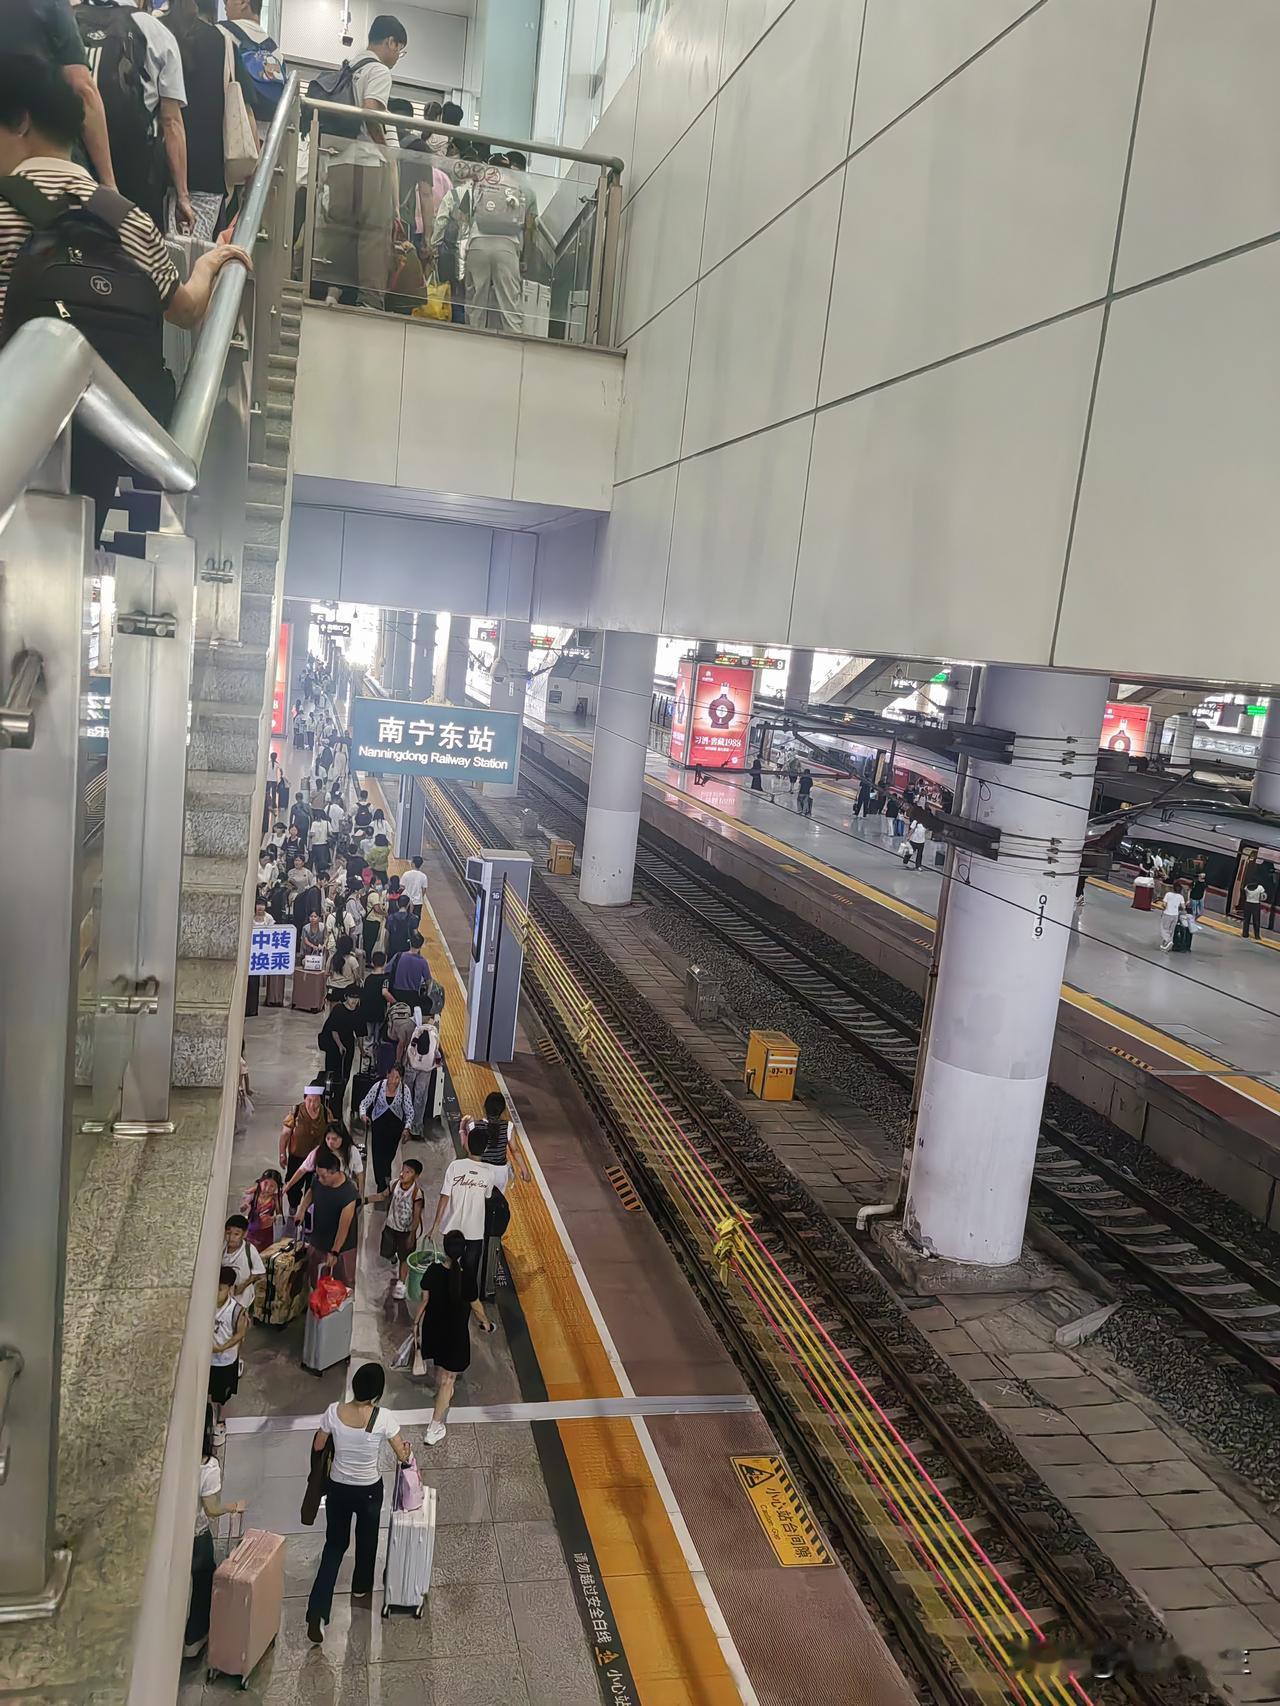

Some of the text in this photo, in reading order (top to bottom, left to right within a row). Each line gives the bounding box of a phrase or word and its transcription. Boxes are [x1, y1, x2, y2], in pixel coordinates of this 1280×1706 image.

[377, 716, 496, 753] 南宁东站
[358, 745, 509, 770] Nanningdong Railway Station
[1034, 894, 1048, 937] Q119
[252, 930, 291, 950] 中转
[250, 952, 290, 971] 换乘
[766, 1487, 812, 1559] 小心站台间隙
[573, 1552, 612, 1644] 请勿越过安全白线
